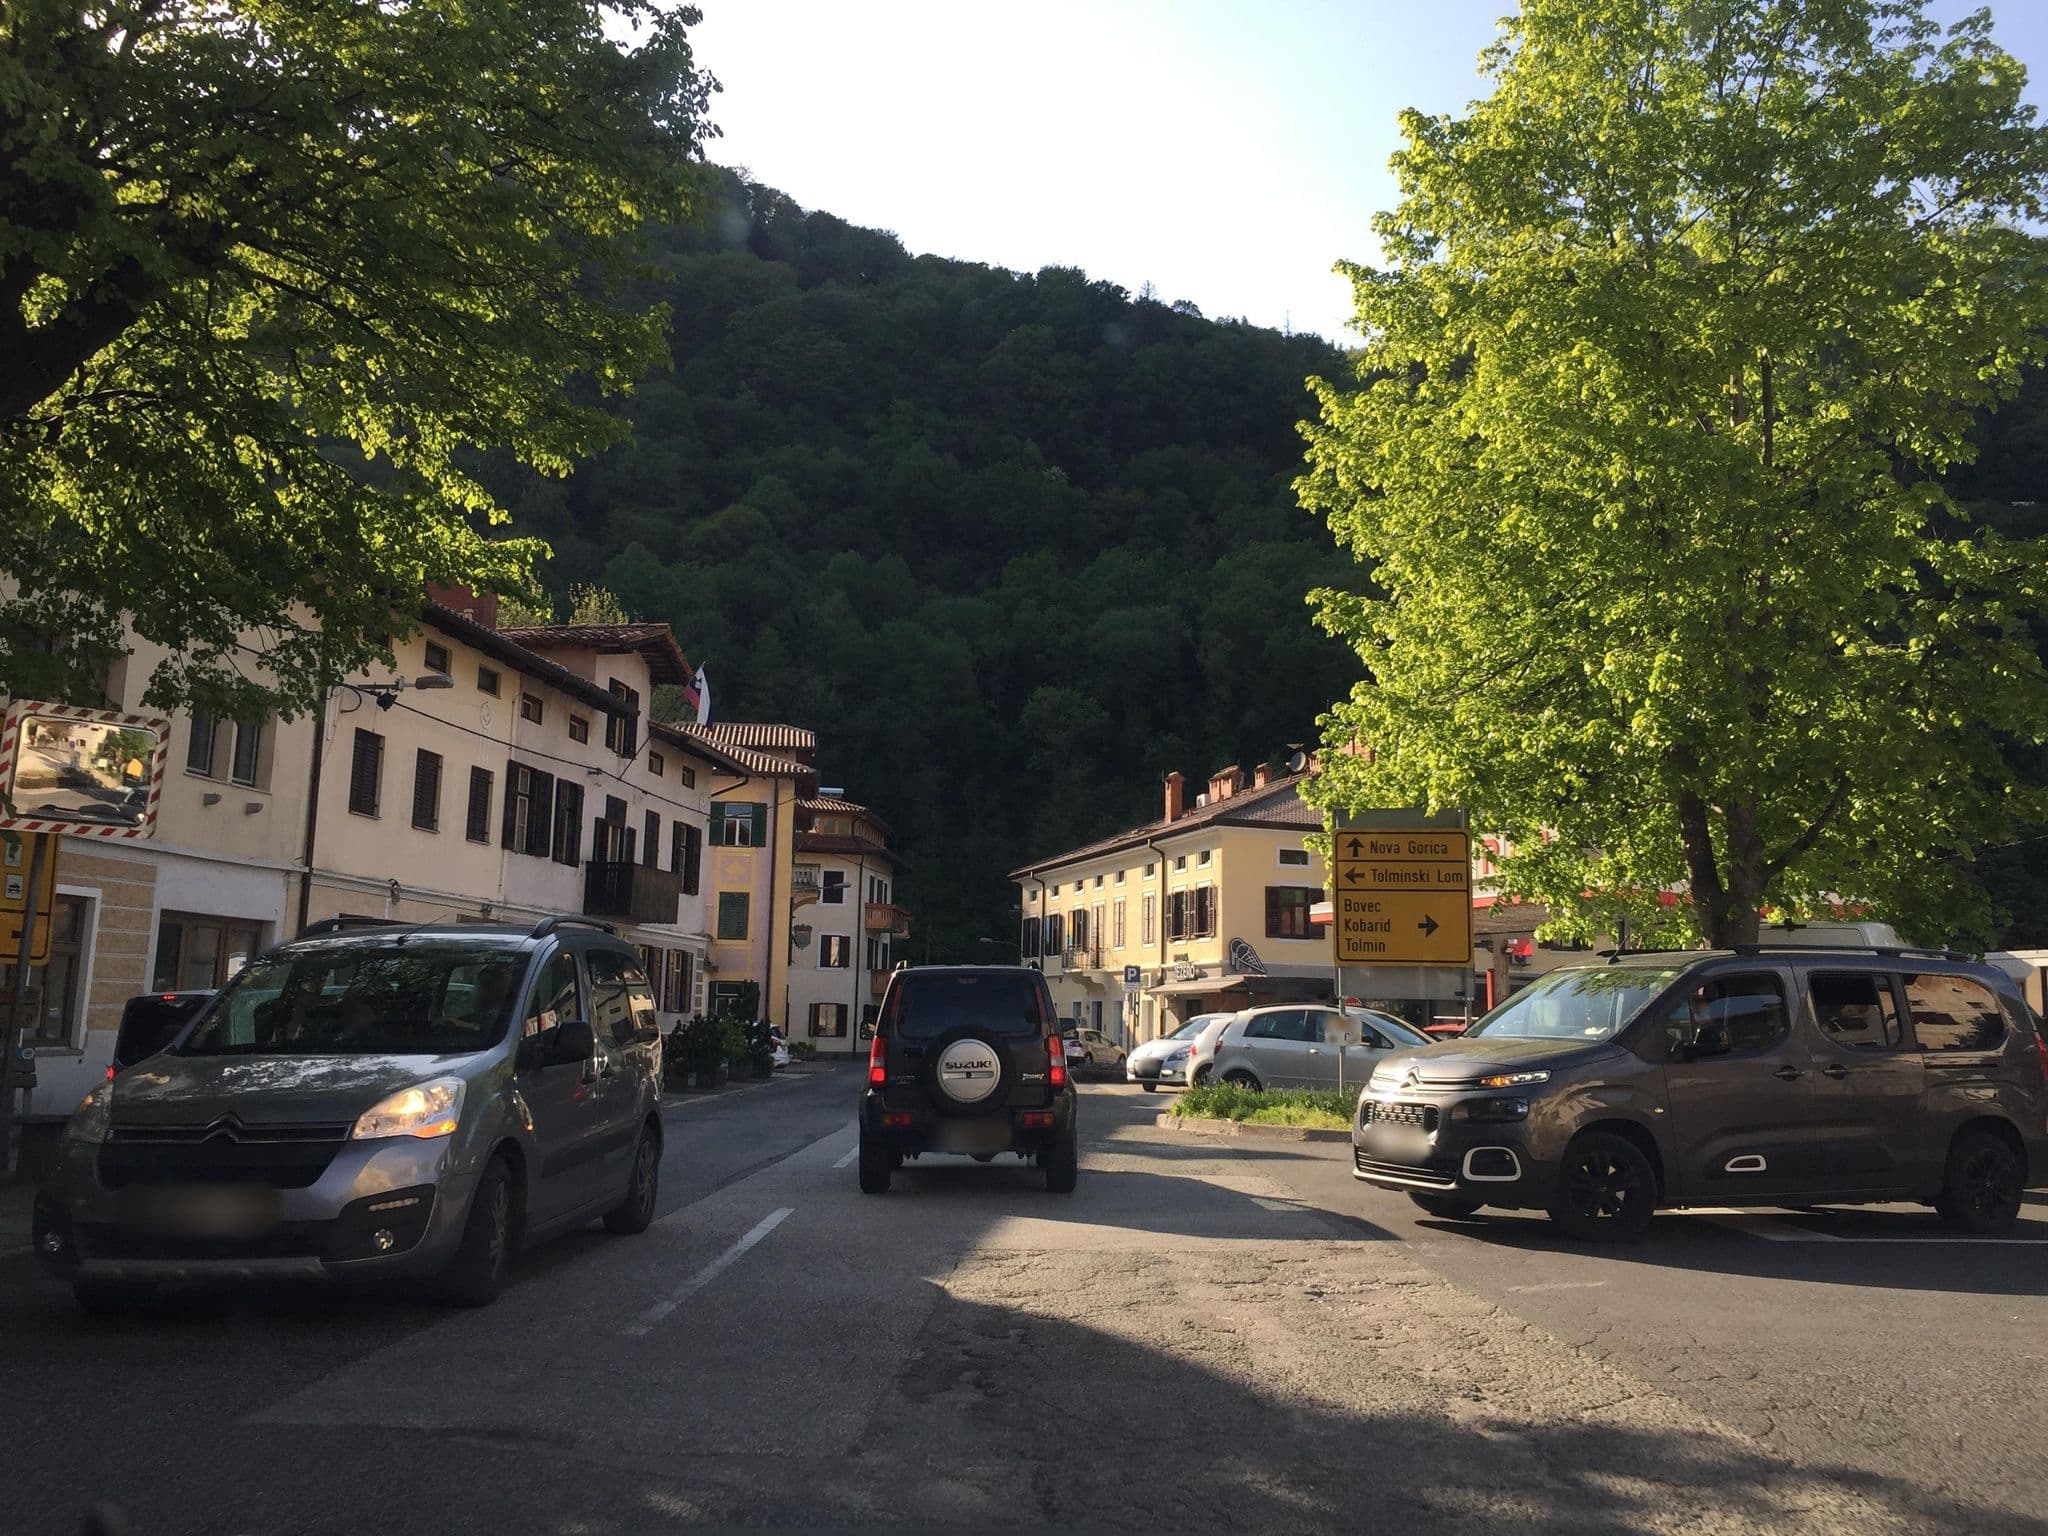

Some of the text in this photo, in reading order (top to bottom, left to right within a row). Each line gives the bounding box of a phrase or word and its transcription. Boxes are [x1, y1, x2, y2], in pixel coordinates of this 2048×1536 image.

[1370, 840, 1449, 855] Nova Gorica
[1371, 868, 1463, 884] Tolminski Lom
[1344, 898, 1382, 913] Bovec
[1344, 918, 1391, 933] Kobarid
[1345, 937, 1386, 953] Tolmin
[1127, 967, 1137, 981] P
[945, 1060, 992, 1070] SUZUKI
